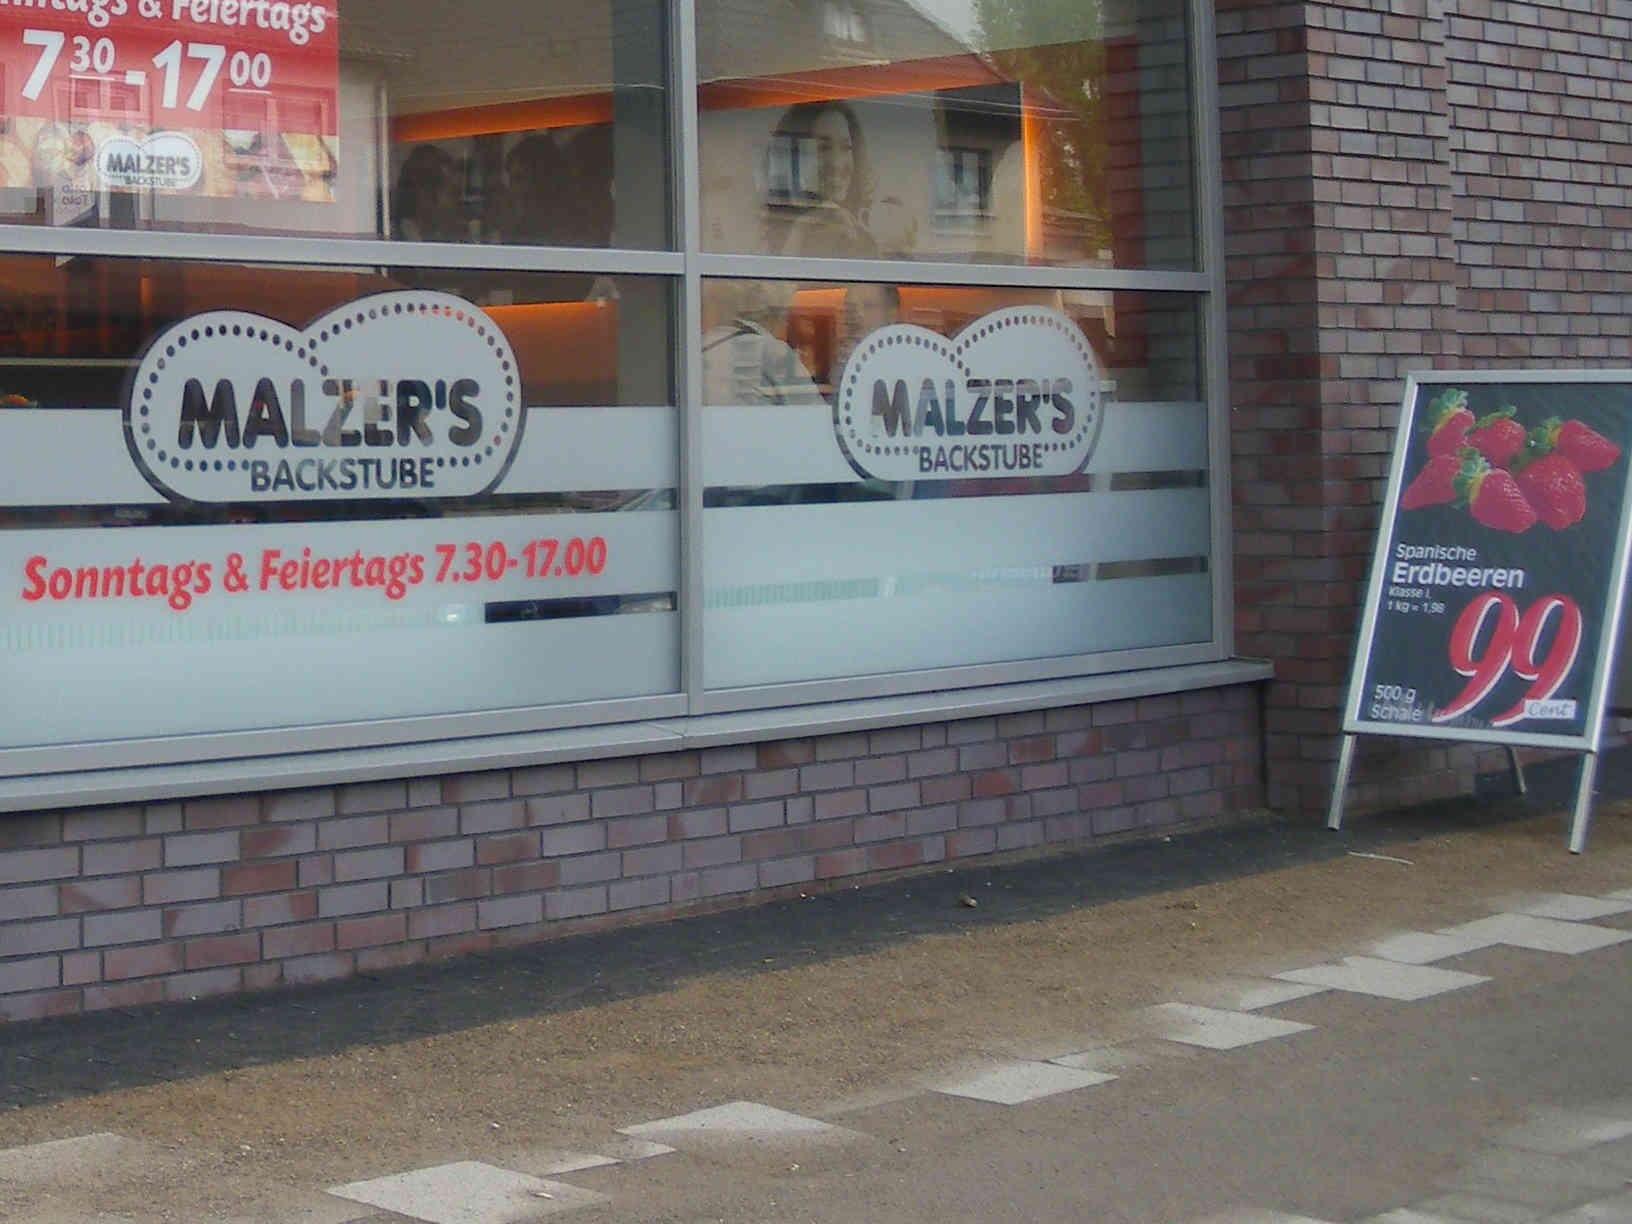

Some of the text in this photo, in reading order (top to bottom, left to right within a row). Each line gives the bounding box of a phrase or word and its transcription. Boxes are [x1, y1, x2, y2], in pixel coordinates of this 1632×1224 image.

[107, 153, 191, 176] MALZER'S
[177, 378, 483, 448] MALZER'S
[871, 378, 1075, 437] MALZER'S
[919, 444, 1043, 472] BACKSTUBE
[250, 457, 435, 492] BACKSTUBE
[21, 554, 212, 611] Sonntags
[223, 552, 249, 593] &
[260, 546, 425, 601] Feiertags
[1392, 562, 1525, 588] Erdbeeren
[1393, 600, 1409, 613] kg
[1449, 589, 1583, 727] 99
[1374, 685, 1416, 704] 500 g
